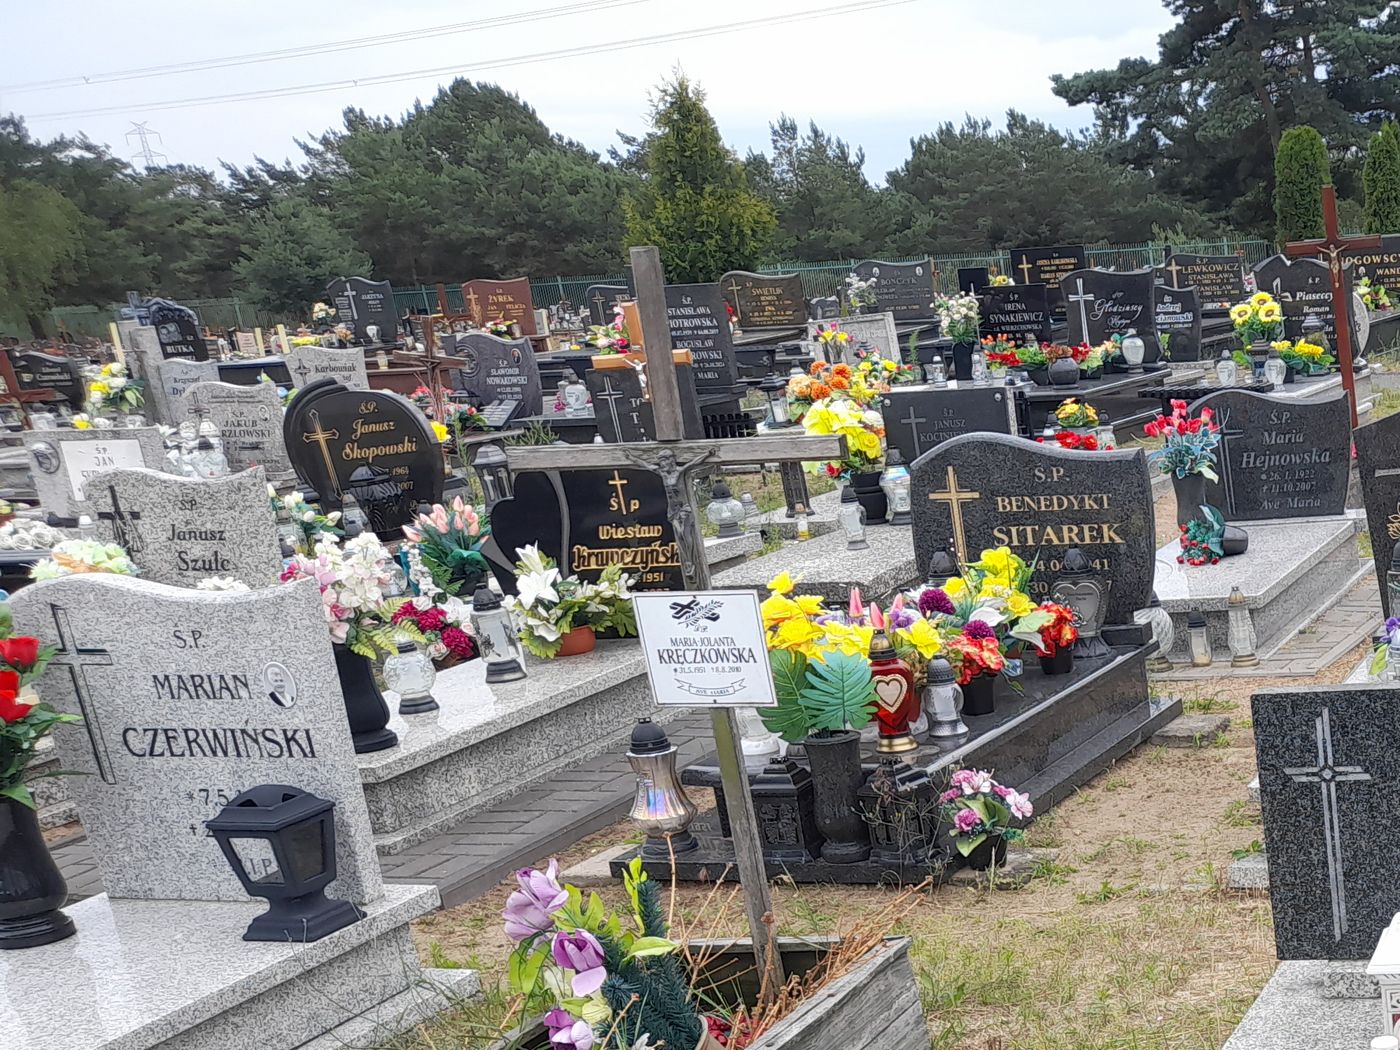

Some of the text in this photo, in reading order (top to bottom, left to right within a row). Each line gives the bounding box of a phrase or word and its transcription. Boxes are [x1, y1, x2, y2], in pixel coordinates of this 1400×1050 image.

[1182, 263, 1239, 273] LEWKOWICZ
[669, 317, 718, 328] IOTROWSKA
[990, 312, 1044, 323] SYNAKIEWICZ
[351, 418, 396, 440] Janusz
[934, 419, 966, 430] JANUSZ
[1262, 430, 1304, 445] Maria
[342, 436, 417, 463] Skopowski
[93, 456, 115, 467] JAN
[1241, 450, 1331, 470] Hejnowska
[995, 494, 1112, 512] BENEDYKT
[168, 524, 226, 541] Janusz
[993, 523, 1125, 547] SITAREK
[177, 551, 231, 571] Szulc
[572, 540, 681, 571] Krawczyńsk
[657, 647, 757, 665] KRĘCZKOWSKA
[152, 674, 253, 700] MARIAN
[122, 719, 317, 758] CZERWIŃSKI
